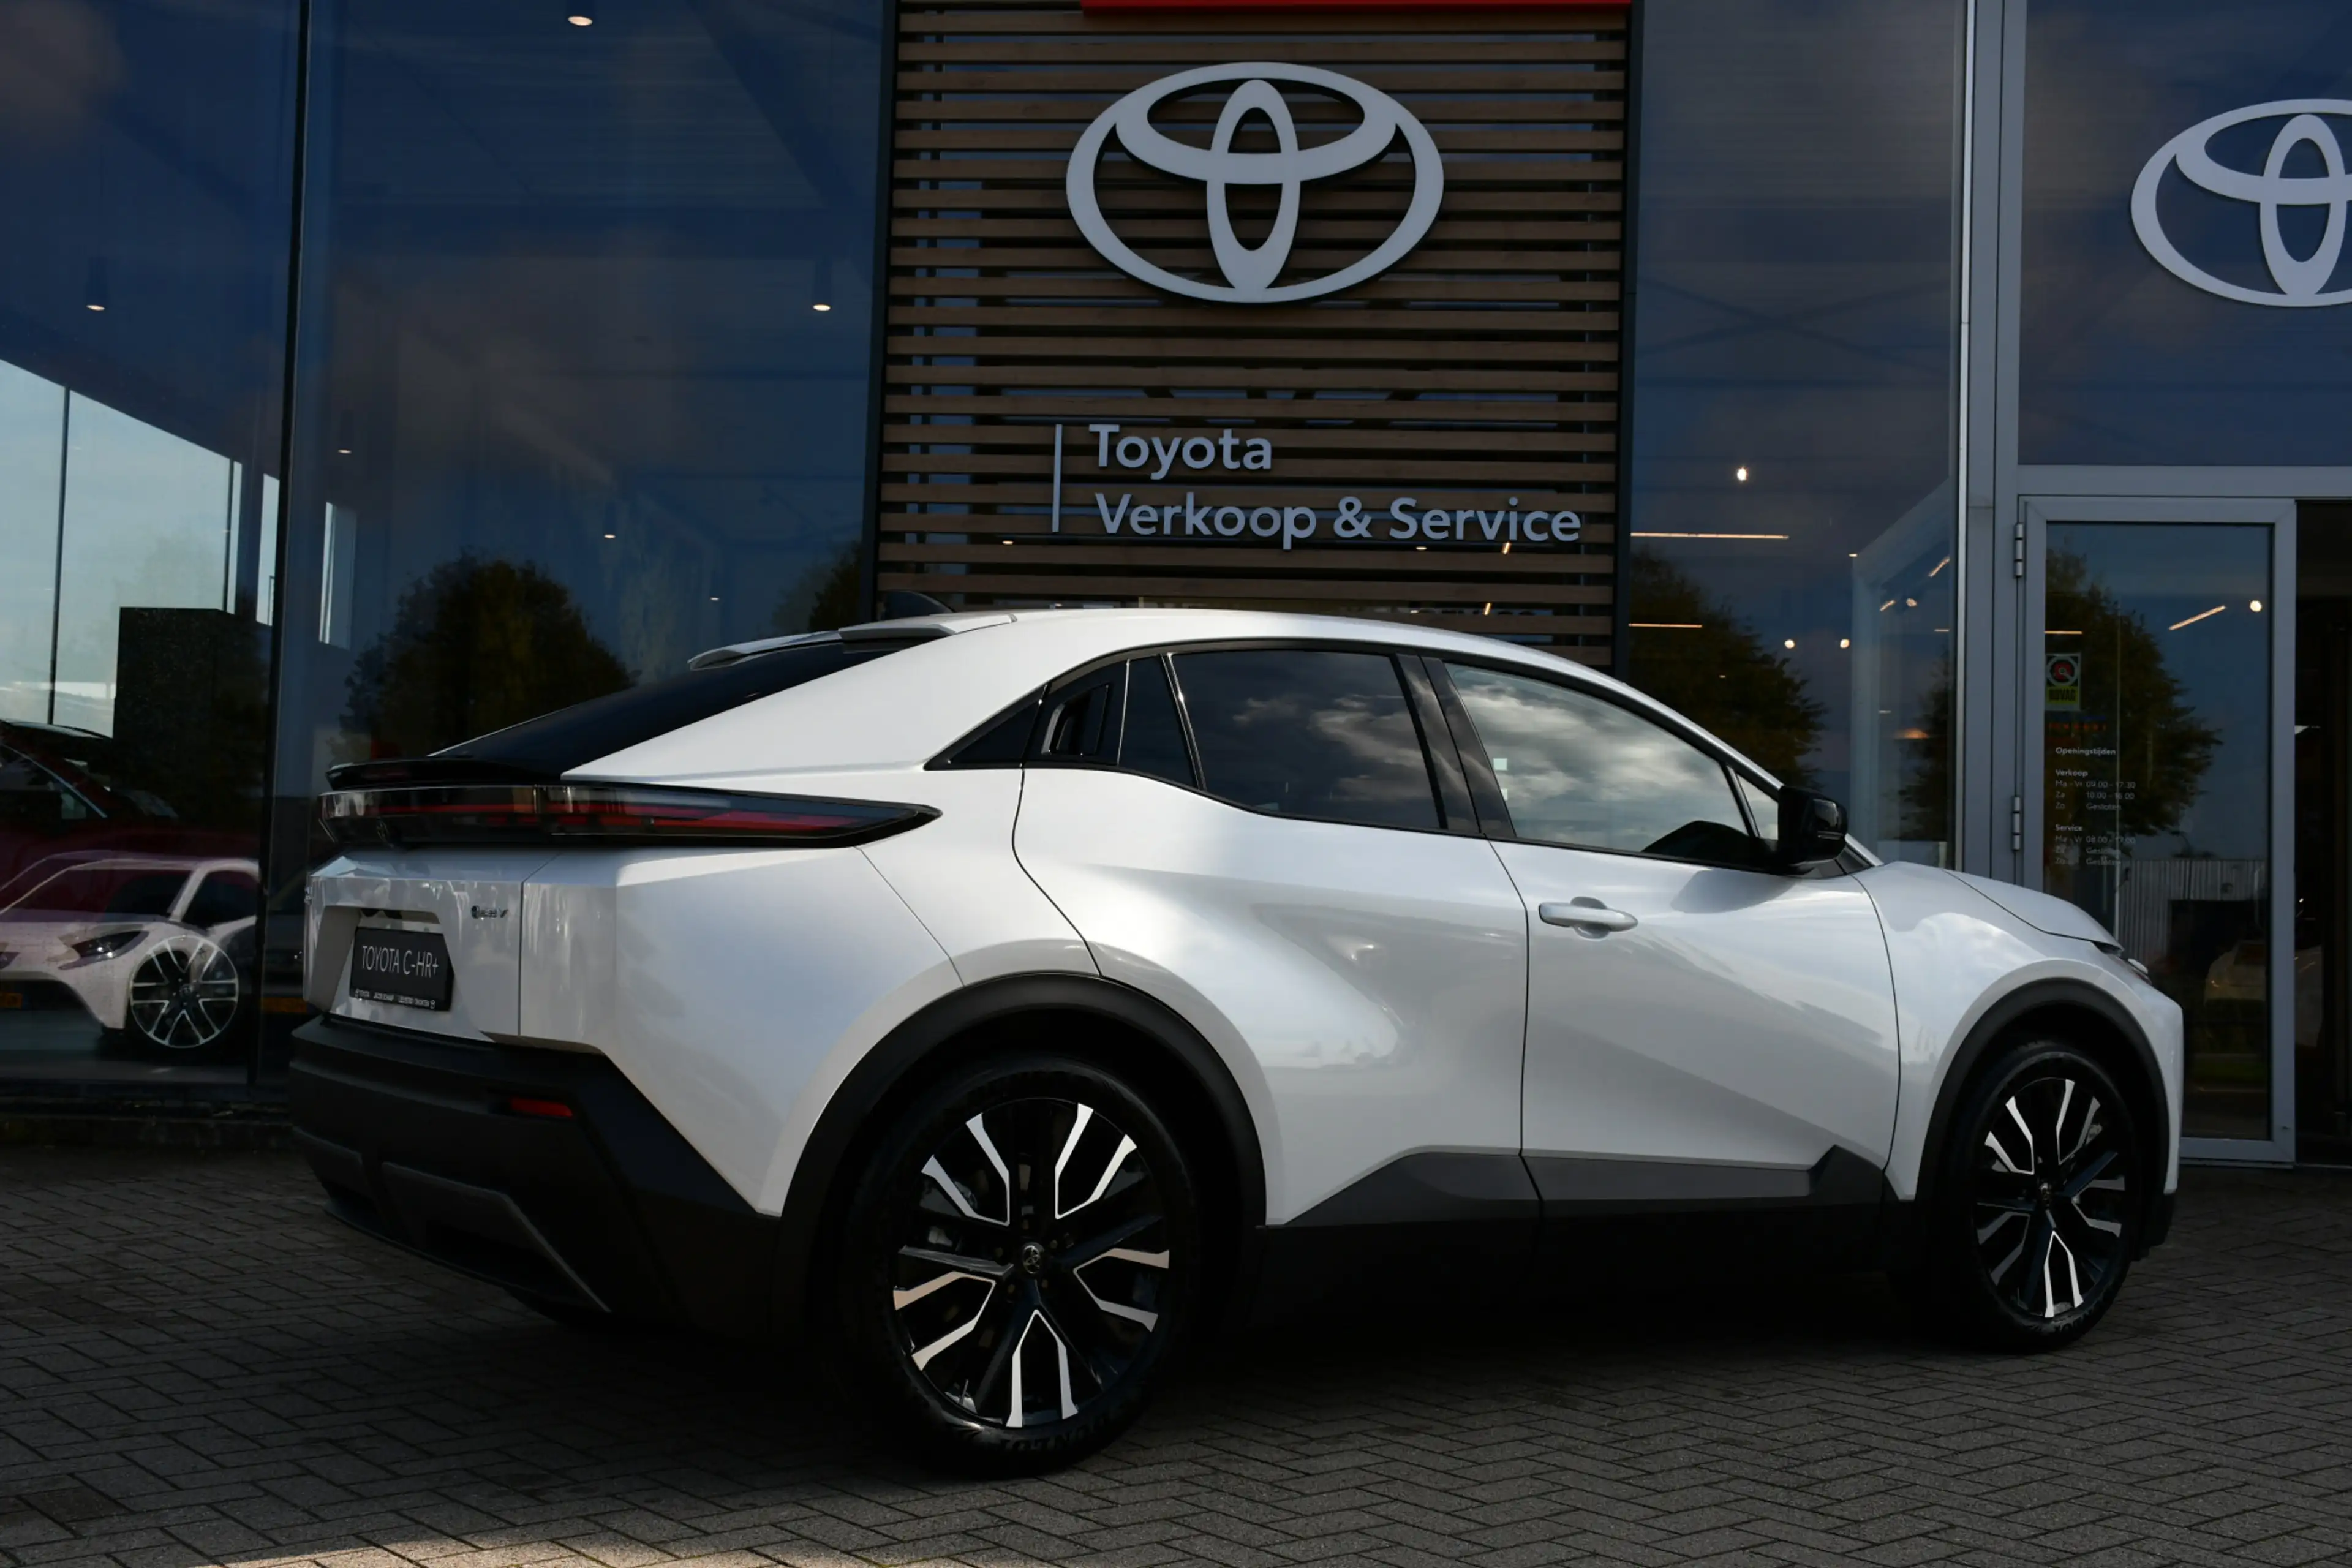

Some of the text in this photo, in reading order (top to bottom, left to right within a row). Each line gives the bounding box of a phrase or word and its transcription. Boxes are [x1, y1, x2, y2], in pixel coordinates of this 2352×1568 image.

[1088, 423, 1272, 480] Toyota
[1095, 491, 1581, 550] Verkoop & Service
[2055, 747, 2116, 756] Openingstijden
[2055, 769, 2088, 778] Verkoop
[2055, 823, 2083, 832] Service
[362, 945, 439, 978] TOYOTA C-HR+
